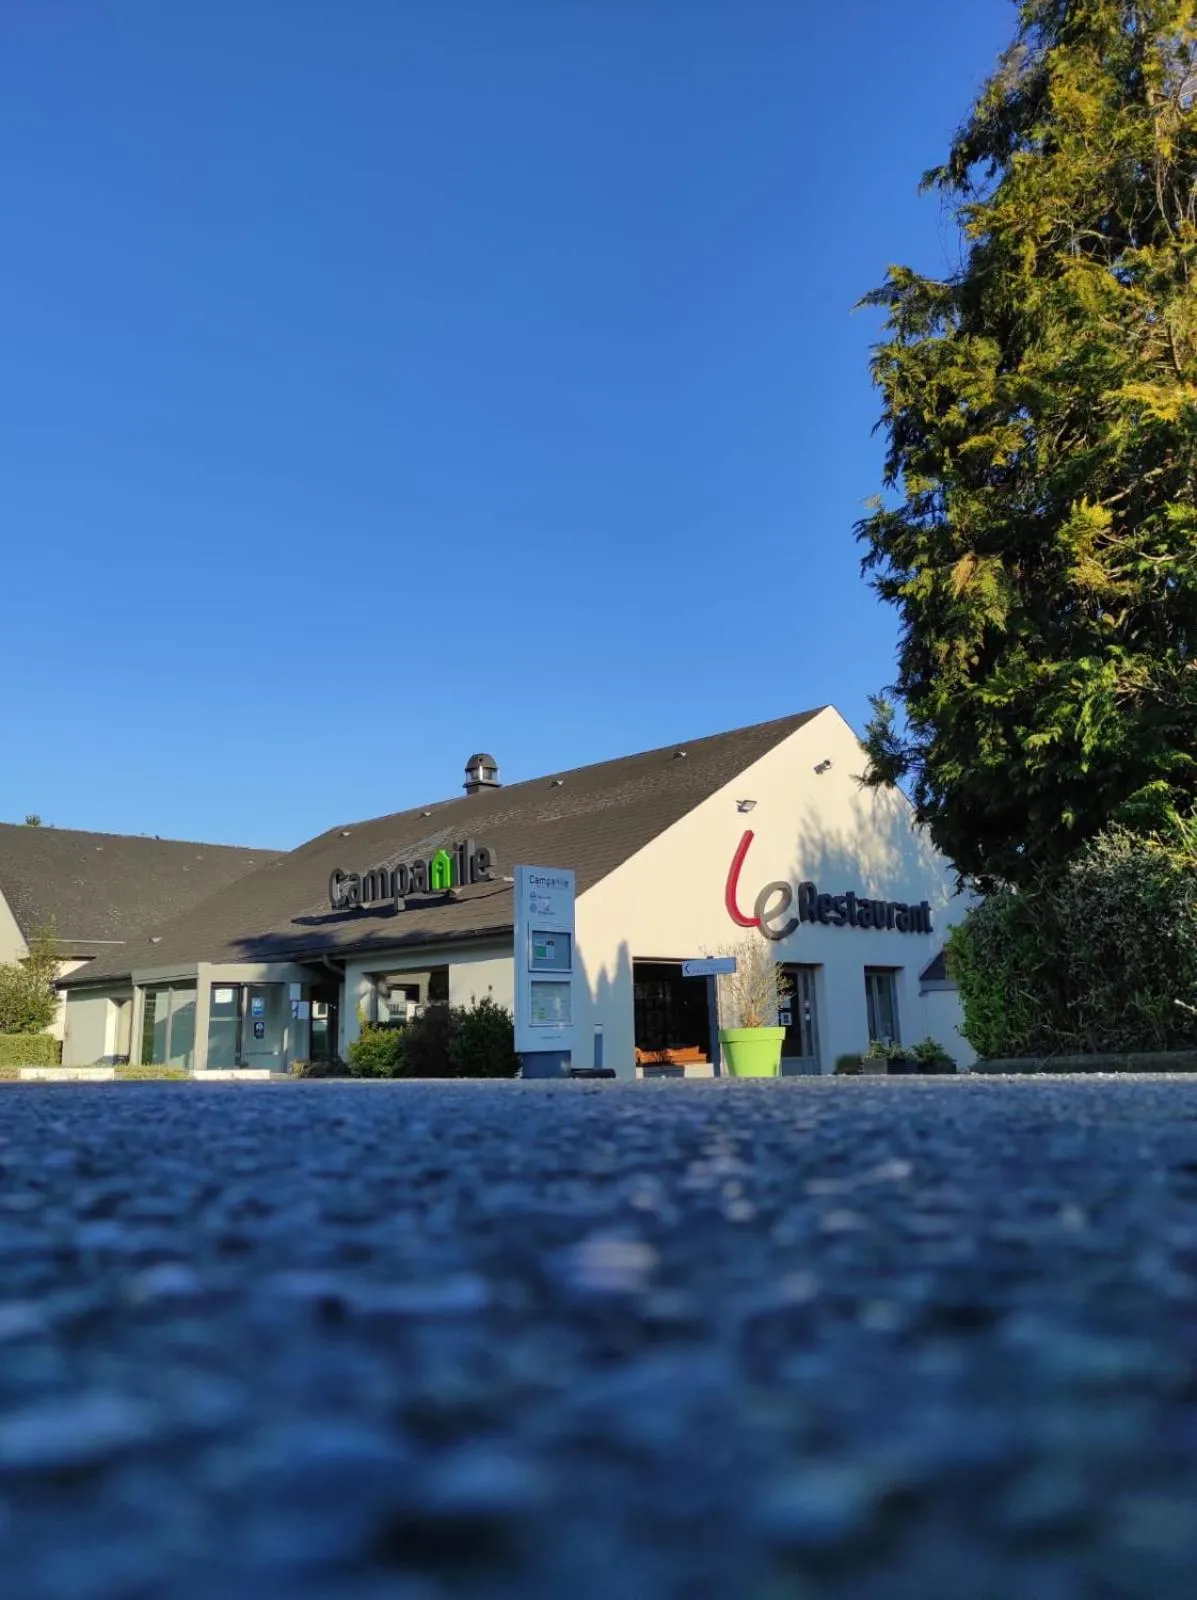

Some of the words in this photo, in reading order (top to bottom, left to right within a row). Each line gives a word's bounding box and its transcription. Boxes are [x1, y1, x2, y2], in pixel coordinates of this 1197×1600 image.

[329, 838, 498, 912] Campanile
[725, 830, 800, 941] Le
[797, 881, 934, 934] Restaurant
